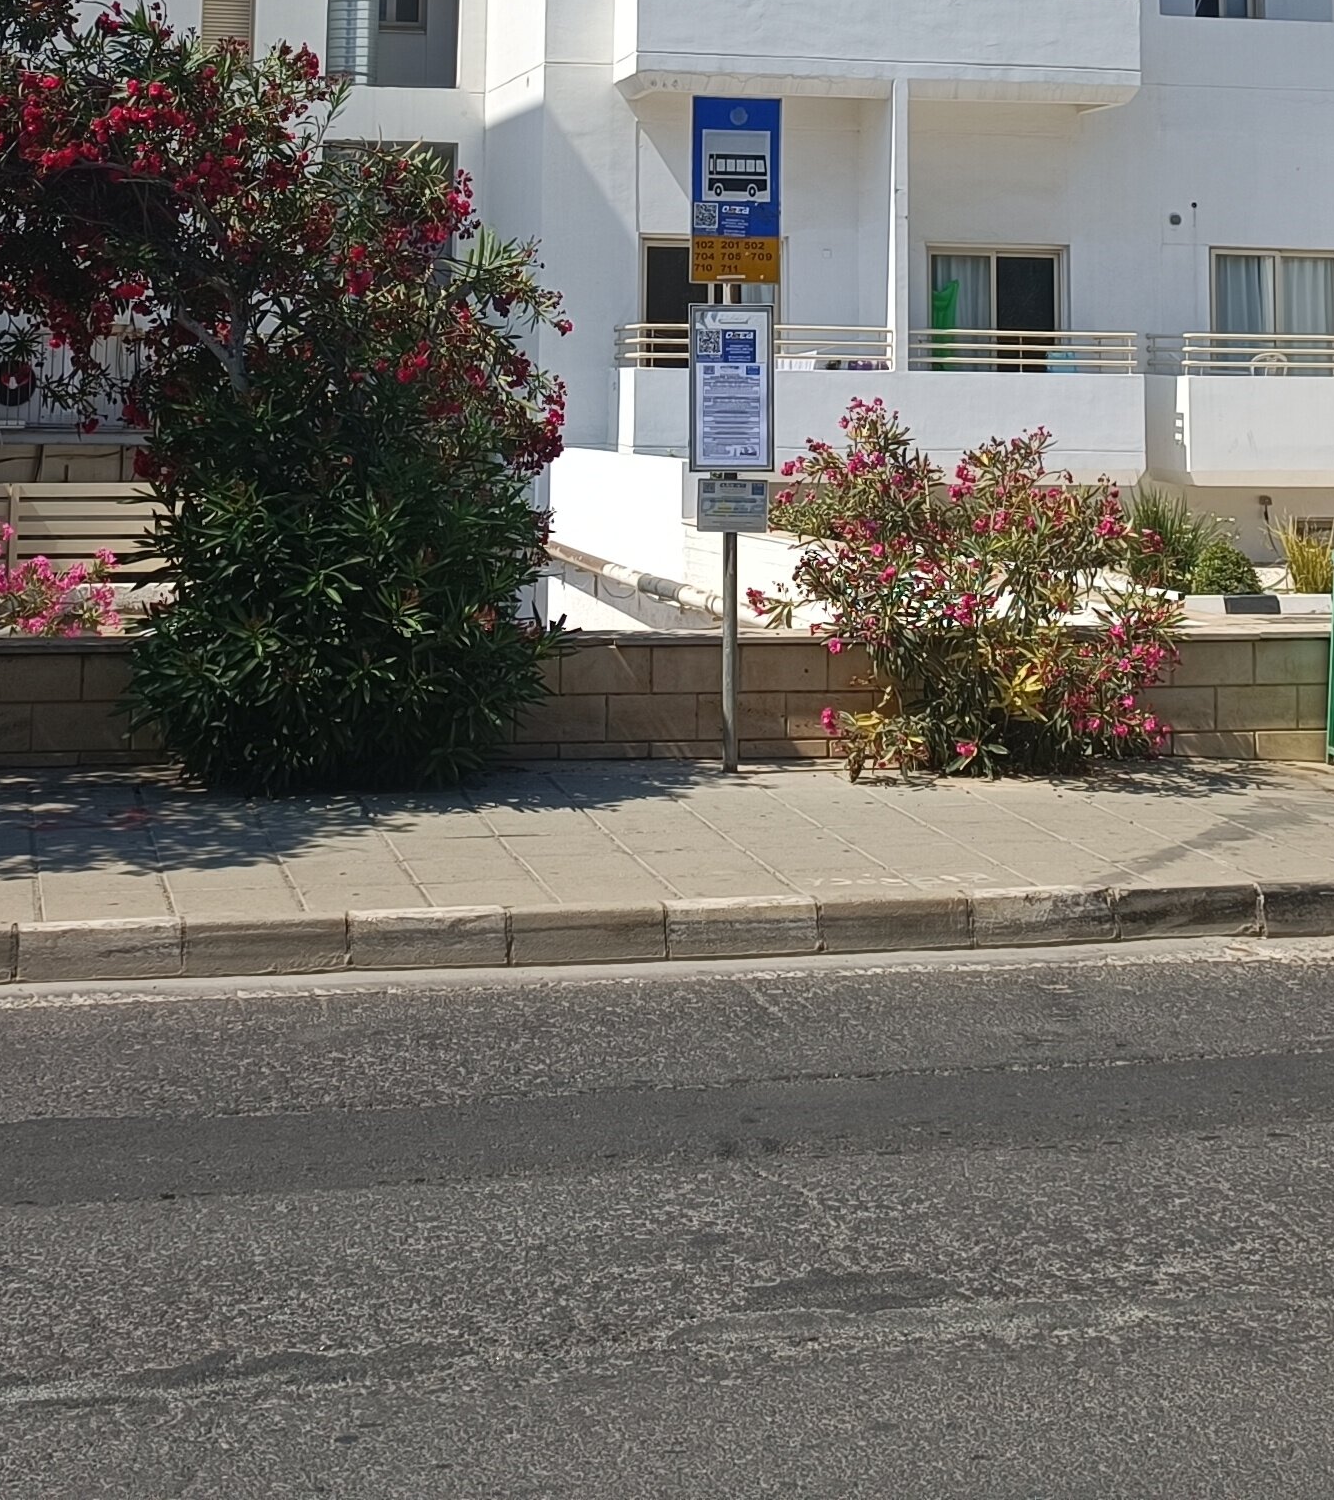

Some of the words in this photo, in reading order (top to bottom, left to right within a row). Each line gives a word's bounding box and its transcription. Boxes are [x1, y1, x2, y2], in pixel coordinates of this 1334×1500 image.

[695, 240, 715, 249] 102
[721, 240, 740, 249] 201
[744, 241, 765, 250] 502
[695, 252, 715, 261] 704
[721, 252, 742, 261] 705
[750, 252, 773, 261] 709
[694, 263, 713, 272] 710
[720, 264, 738, 273] 711
